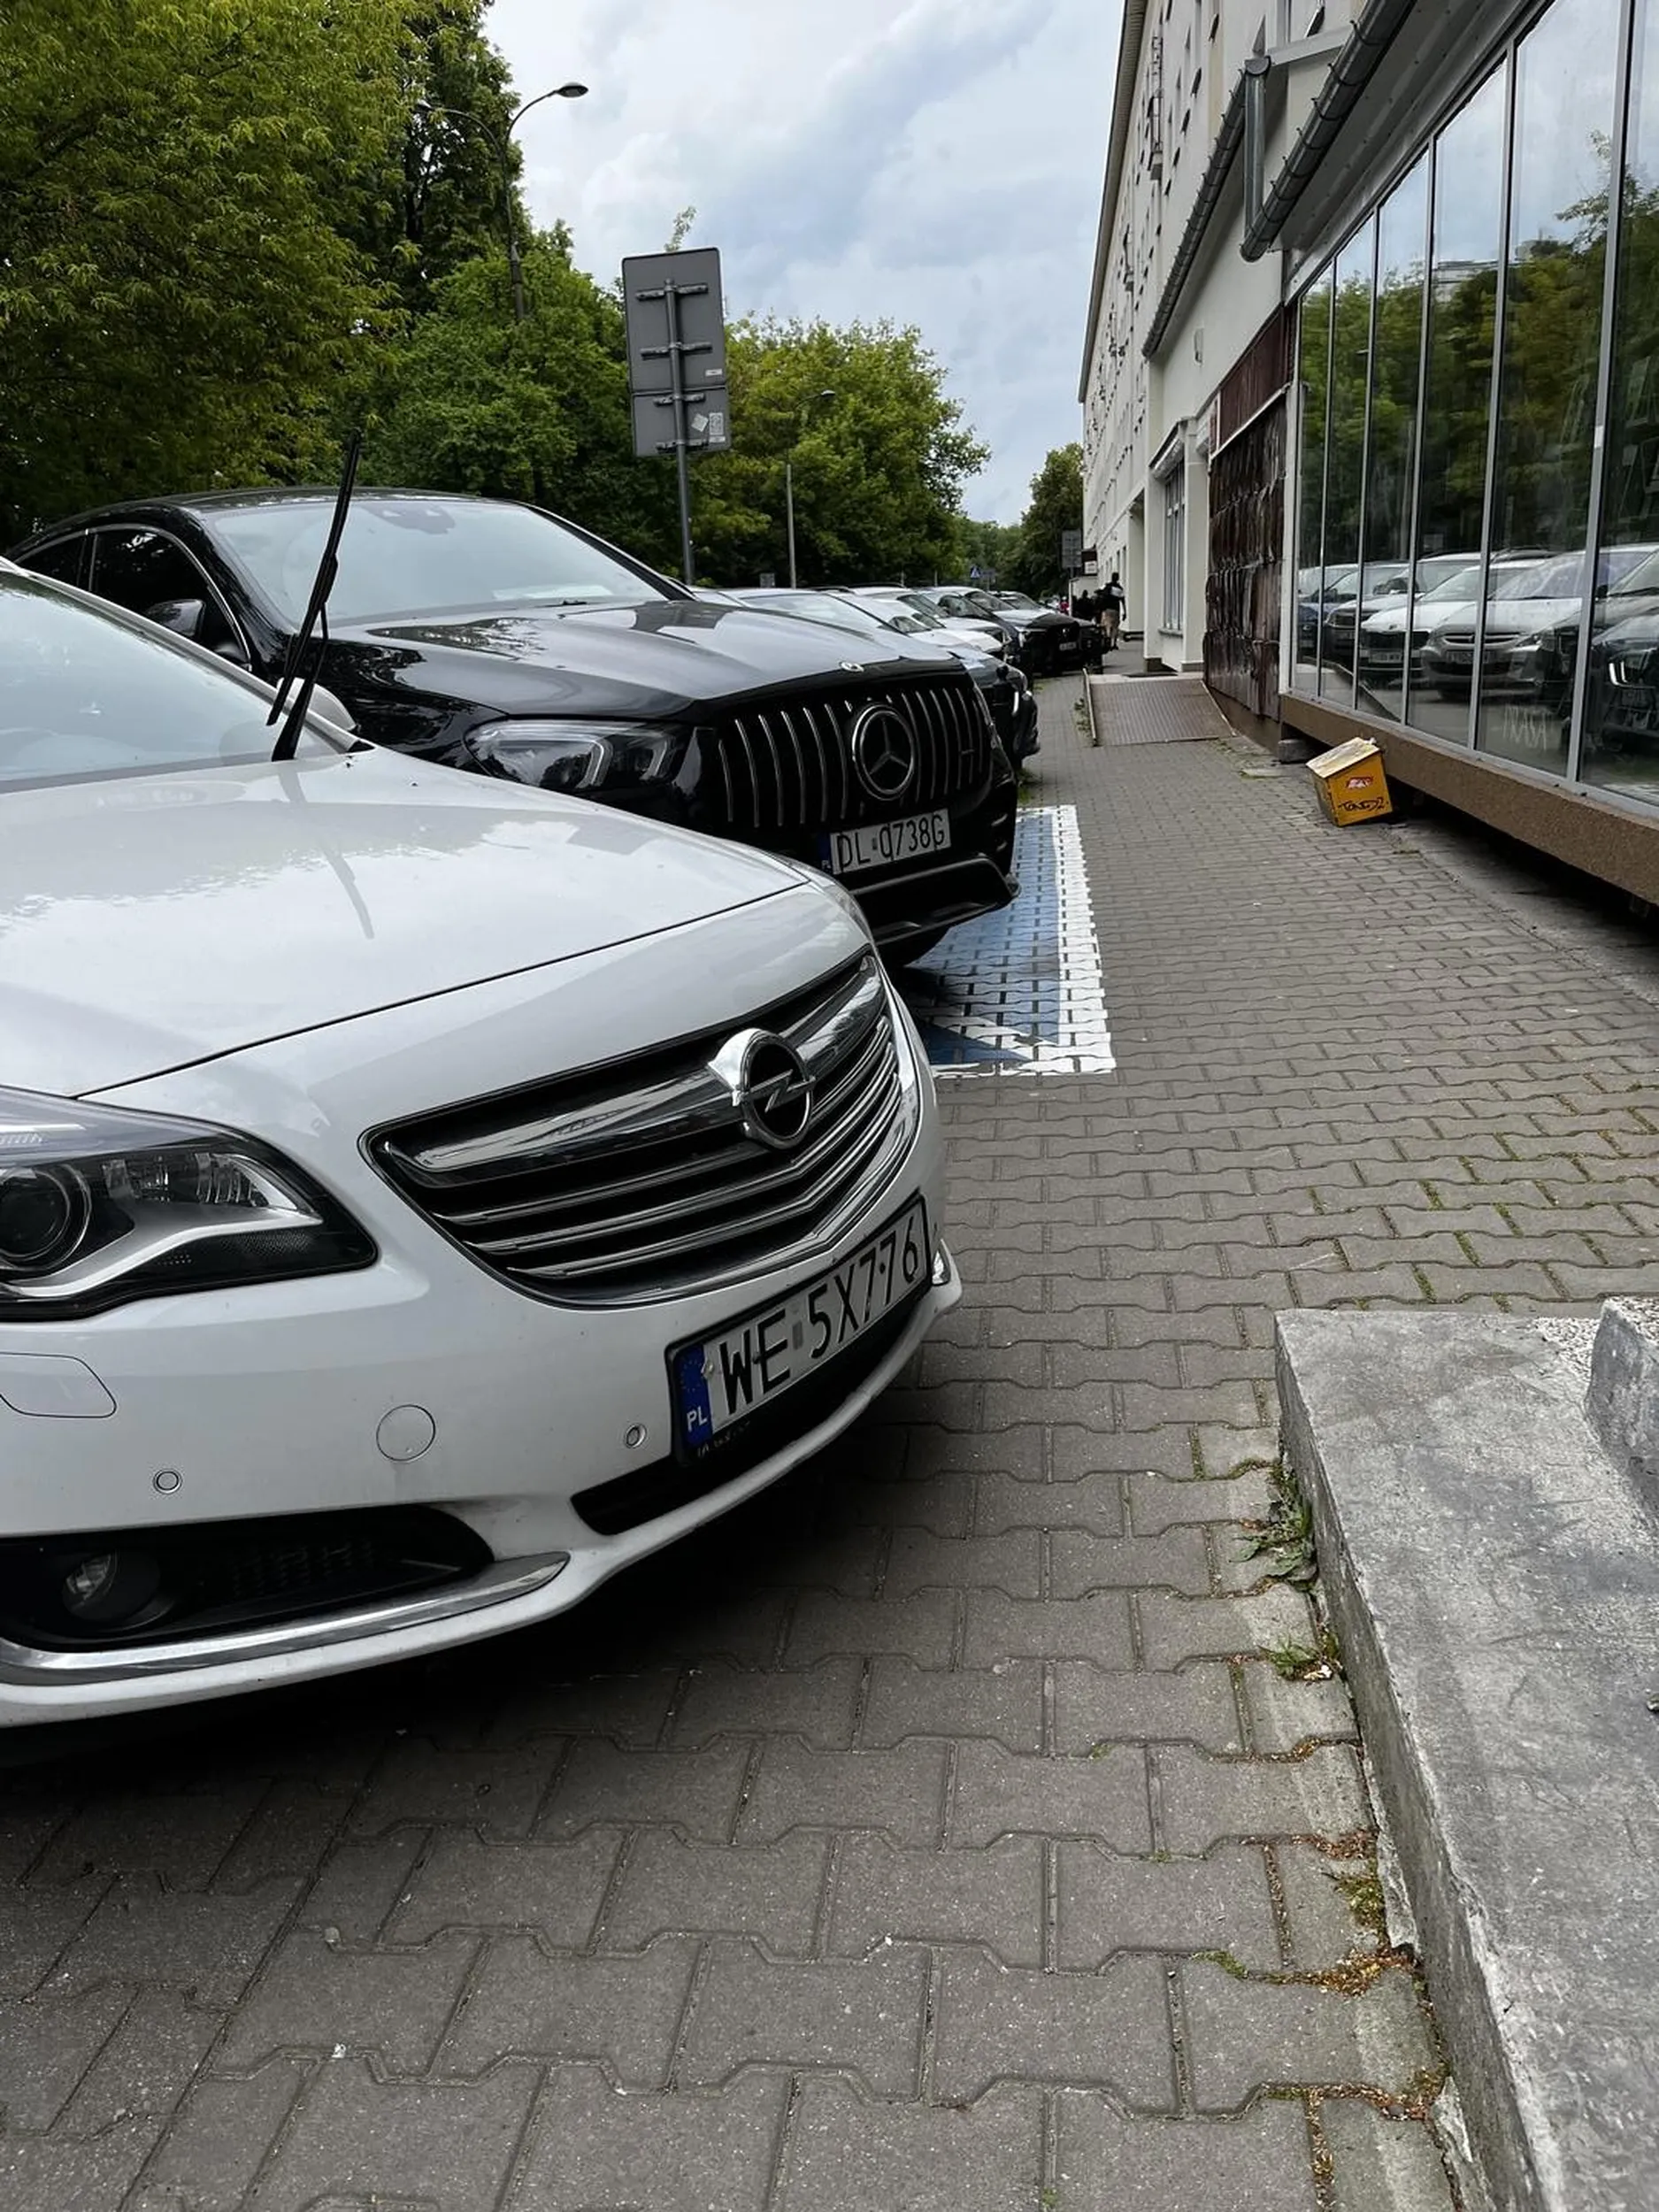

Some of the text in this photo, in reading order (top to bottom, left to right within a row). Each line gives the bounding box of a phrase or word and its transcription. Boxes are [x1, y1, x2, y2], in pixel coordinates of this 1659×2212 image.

[837, 813, 945, 867] DL 0738G
[719, 1215, 918, 1415] WE 5X776
[686, 1405, 708, 1432] PL
